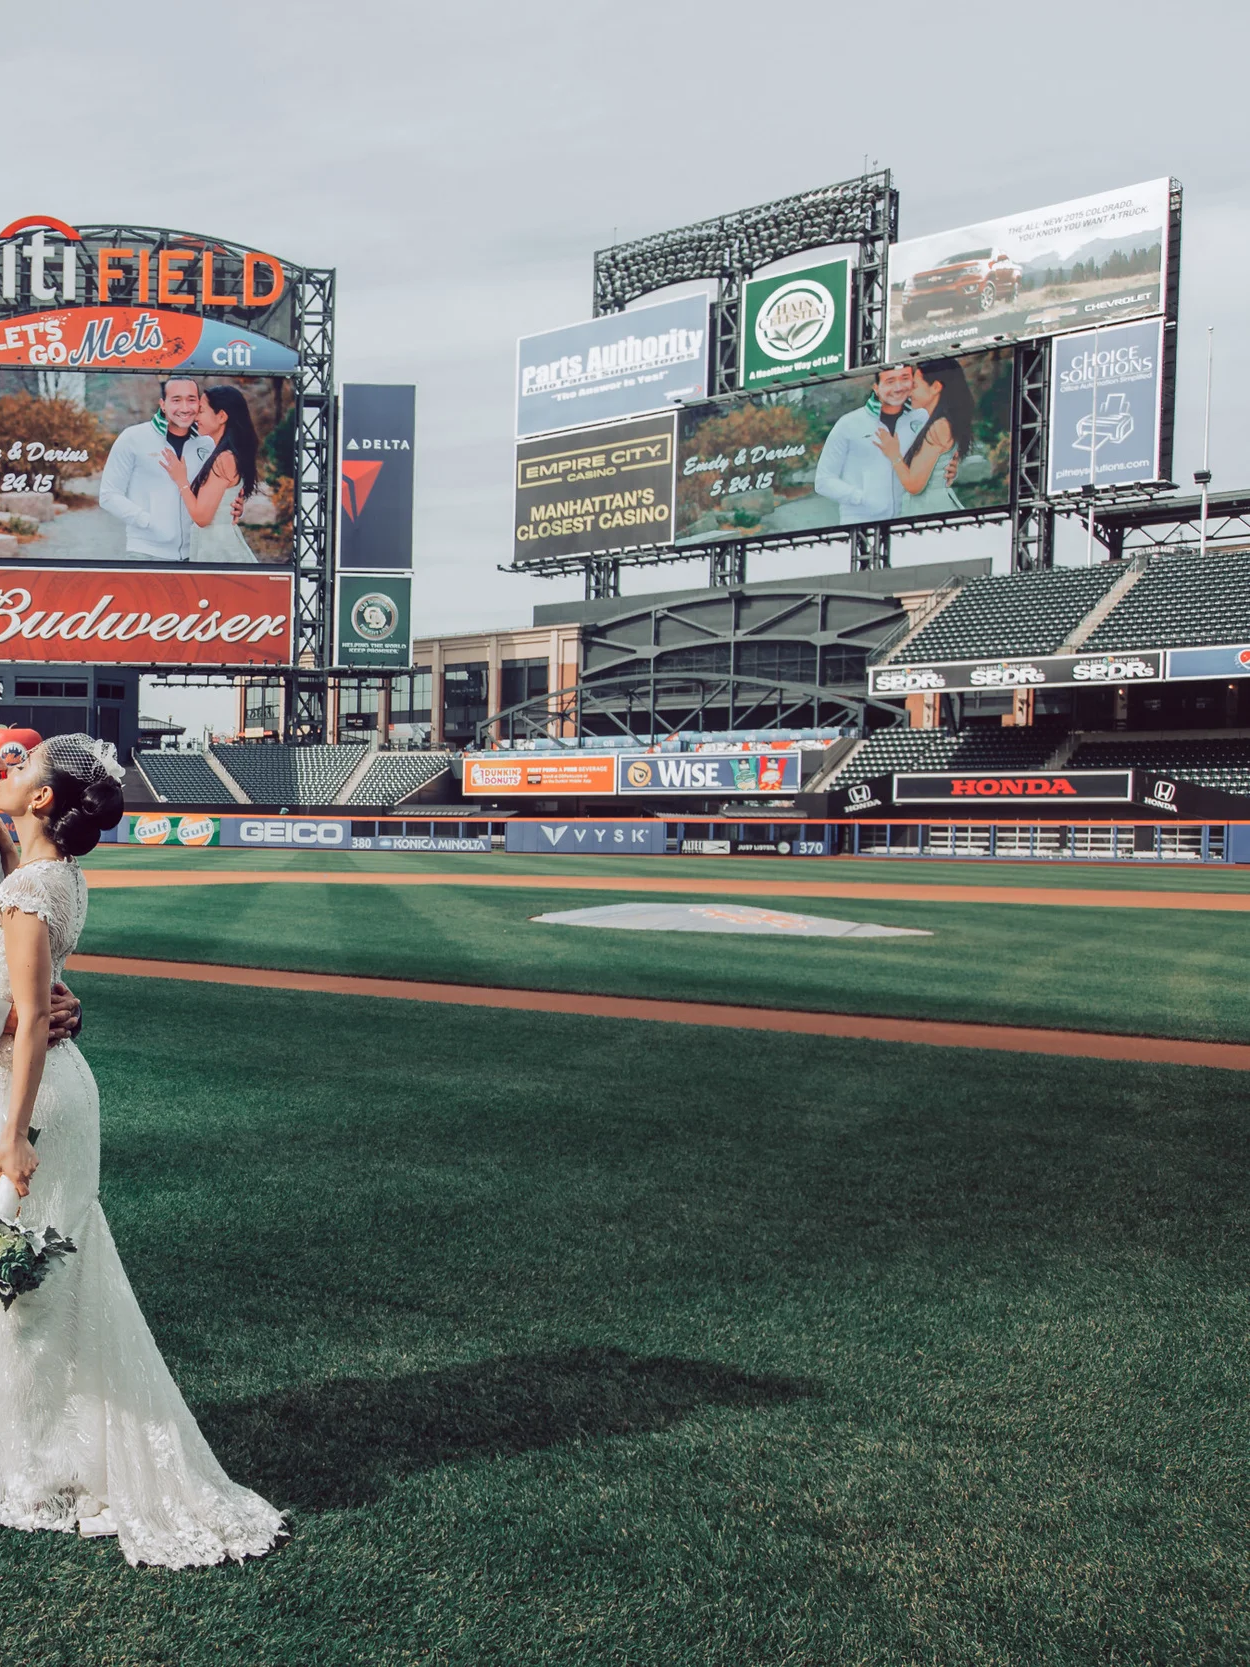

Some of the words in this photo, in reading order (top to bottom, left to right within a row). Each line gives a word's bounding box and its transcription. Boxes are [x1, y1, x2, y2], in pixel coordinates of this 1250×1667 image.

[1008, 226, 1022, 235] THE
[1064, 211, 1084, 222] 2015
[1018, 232, 1035, 242] YOU
[1036, 227, 1062, 239] KNOW
[1064, 221, 1080, 232] YOU
[1082, 216, 1108, 228] WANT
[1118, 206, 1149, 220] TRUCK.
[99, 248, 285, 306] FIELD
[777, 300, 812, 316] HAIN
[1084, 292, 1152, 312] CHEVROLET
[758, 304, 826, 330] CELESTIAL
[28, 342, 67, 365] GO
[68, 313, 162, 366] Mets
[900, 327, 978, 348] ChevyDealer.com
[212, 344, 252, 366] citi
[522, 354, 582, 388] Parts
[586, 328, 704, 372] Authority
[1071, 345, 1140, 370] CHOICE
[526, 383, 556, 394] Auto
[561, 374, 597, 386] Parts
[600, 353, 695, 376] Superstores
[749, 372, 755, 380] A
[756, 364, 794, 378] Healthier
[794, 360, 812, 371] Way
[812, 358, 821, 367] of
[822, 354, 839, 365] Life
[1060, 356, 1152, 385] SOLUTIONS
[578, 380, 622, 397] Answer
[1060, 384, 1079, 392] Office
[1120, 372, 1152, 383] Simplified
[7, 441, 22, 461] &
[26, 441, 90, 462] Darius
[362, 438, 410, 450] DELTA
[734, 448, 747, 466] &
[750, 444, 806, 464] Darius
[526, 454, 606, 479] EMPIRE
[566, 466, 617, 482] CASINO
[710, 472, 775, 497] 5.24.15
[530, 488, 655, 522] MANHATTAN'S
[517, 515, 595, 541] CLOSEST
[598, 504, 670, 530] CASINO
[485, 768, 521, 777] DUNKIN'
[657, 760, 720, 788] WISE
[951, 778, 1078, 796] HONDA
[844, 799, 882, 813] HONDA
[1144, 798, 1178, 813] HONDA
[138, 821, 167, 838] Gulf
[180, 822, 210, 838] Gulf
[240, 821, 343, 844] GEICO
[352, 837, 371, 849] 380
[394, 838, 436, 849] KONICA
[438, 838, 485, 850] MINOLTA
[799, 842, 823, 854] 370
